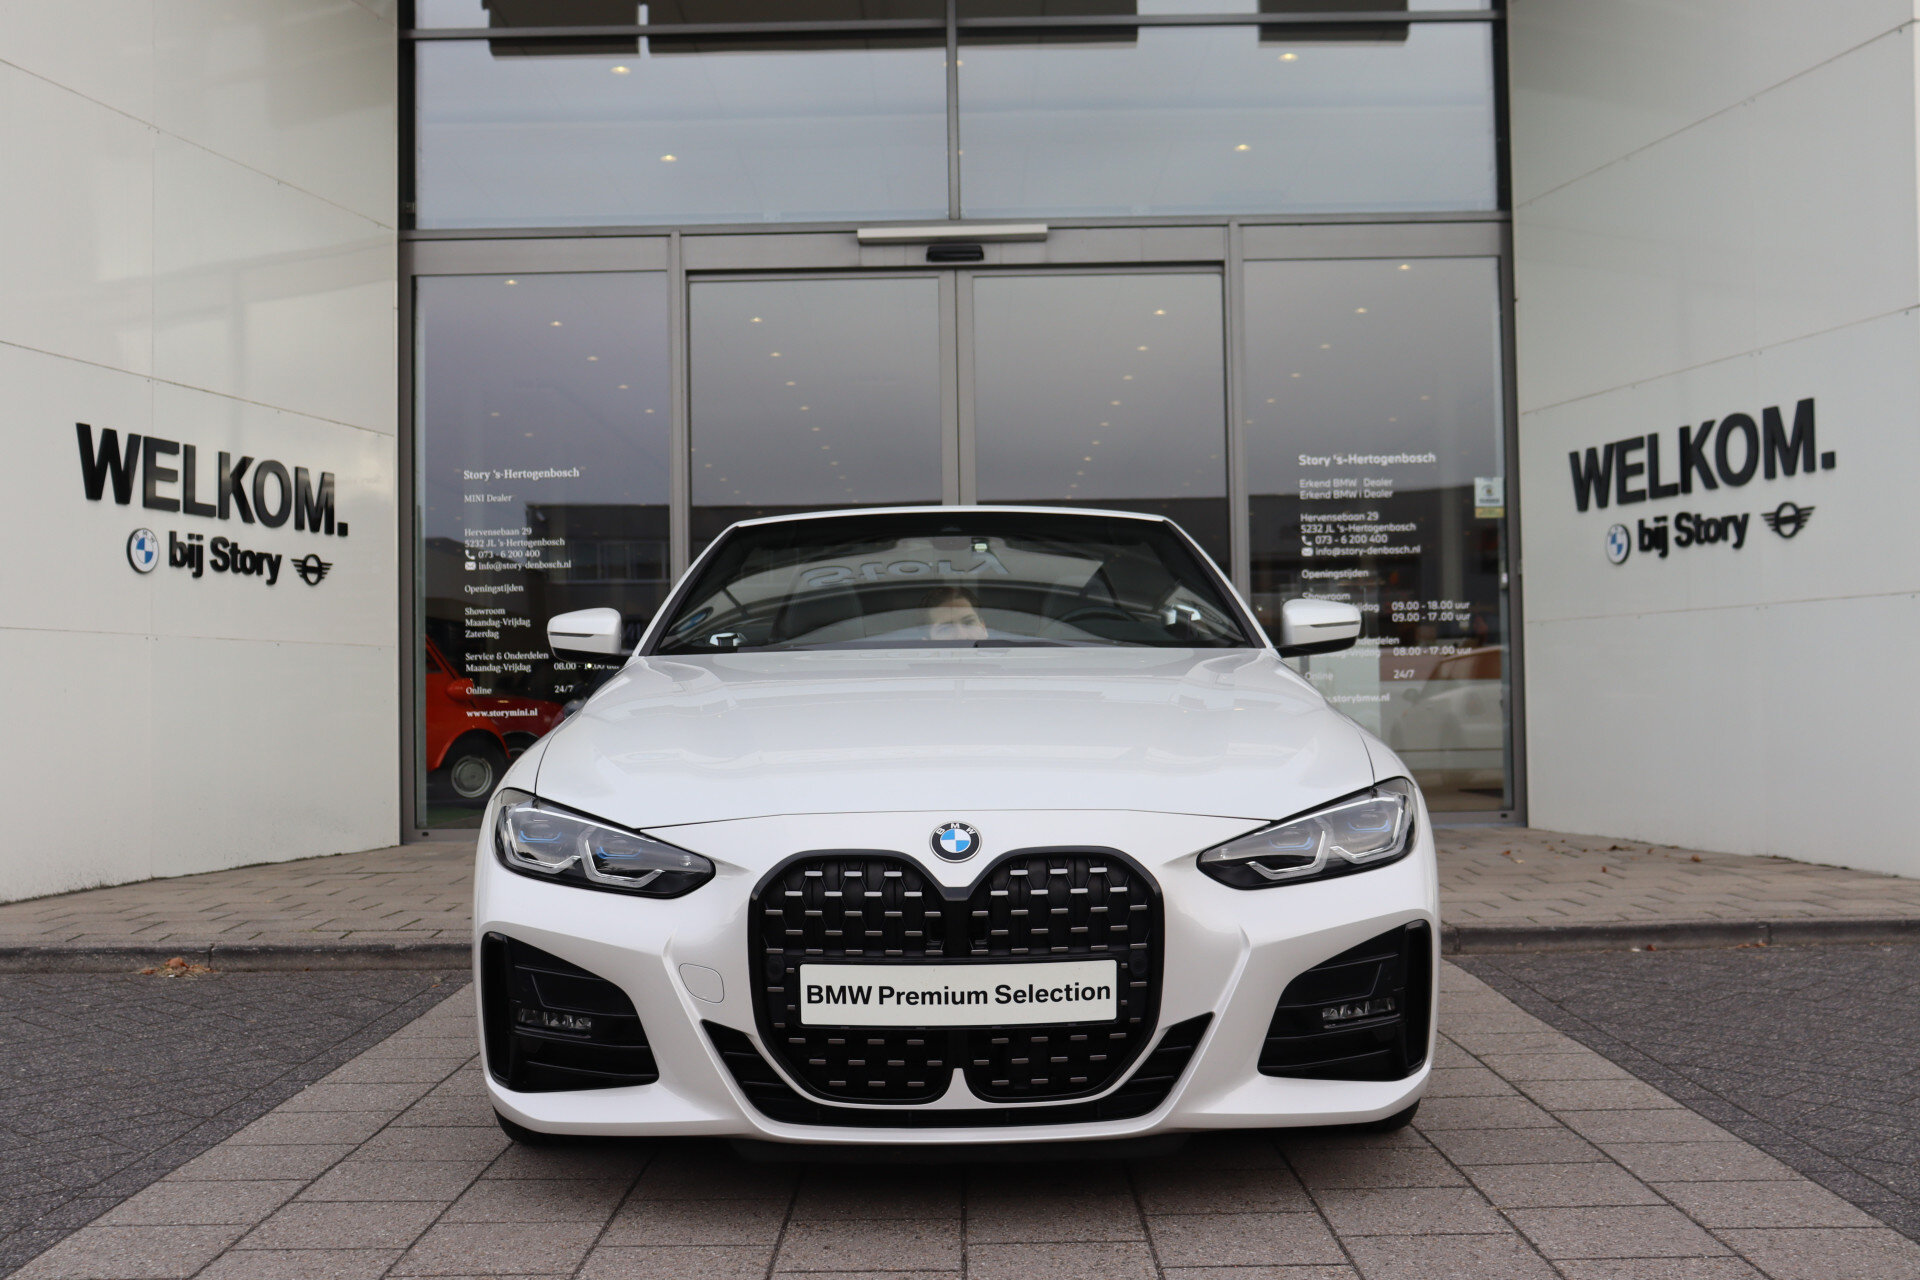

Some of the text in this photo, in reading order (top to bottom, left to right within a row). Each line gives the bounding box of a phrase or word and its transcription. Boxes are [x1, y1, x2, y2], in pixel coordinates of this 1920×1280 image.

[1298, 452, 1436, 467] Story 's-Hertogenbosch
[1569, 398, 1836, 512] WELKOM.
[464, 467, 580, 482] Story 's-Hertogenbosch
[76, 423, 348, 537] WELKOM.
[1300, 478, 1393, 488] Erkend BMW Dealer
[464, 494, 512, 502] MINI Dealer
[1300, 490, 1331, 500] Erkend
[1332, 490, 1357, 499] BMW
[1364, 489, 1393, 498] Dealer
[1300, 511, 1379, 522] Hervensebaan 29
[464, 527, 532, 536] Hervensebaan 29
[1300, 523, 1416, 534] 5232 JL 's-Hertogenbosch
[1315, 535, 1332, 544] 073
[1340, 535, 1347, 544] 6
[1348, 534, 1367, 544] 200
[1369, 534, 1388, 543] 400
[1638, 512, 1750, 559] bij Story
[465, 538, 566, 548] 5232 JL 's-Hertogenbosch
[478, 550, 494, 559] 073
[500, 550, 506, 558] 6
[508, 550, 522, 558] 200
[524, 549, 540, 558] 400
[1315, 545, 1421, 556] info@story-denbosch.nl
[169, 531, 282, 585] bij Story
[1301, 569, 1369, 580] Openingstijden
[464, 584, 524, 594] Openingstijden
[1302, 592, 1350, 600] Showroom
[1391, 601, 1420, 610] 09.00
[1427, 600, 1453, 610] 18.00
[464, 608, 506, 616] Showroom
[1392, 612, 1420, 622] 09.00
[1428, 612, 1454, 621] 17.00
[465, 618, 531, 628] Maandag-Vrijdag
[465, 630, 500, 639] Zaterdag
[1356, 635, 1400, 645] nderdelen
[465, 651, 549, 660] Service & Onderdelen
[1392, 646, 1421, 656] 08.00
[1430, 646, 1454, 655] 17.00
[466, 662, 532, 673] Maandag-Vrijdag
[554, 662, 576, 670] 08.00
[1304, 669, 1415, 680] Online 24/7
[466, 685, 574, 695] Online 24/7
[466, 708, 538, 718] www.storymini.nl
[936, 822, 976, 835] BMW
[806, 982, 1111, 1006] BMW Premium Selection
